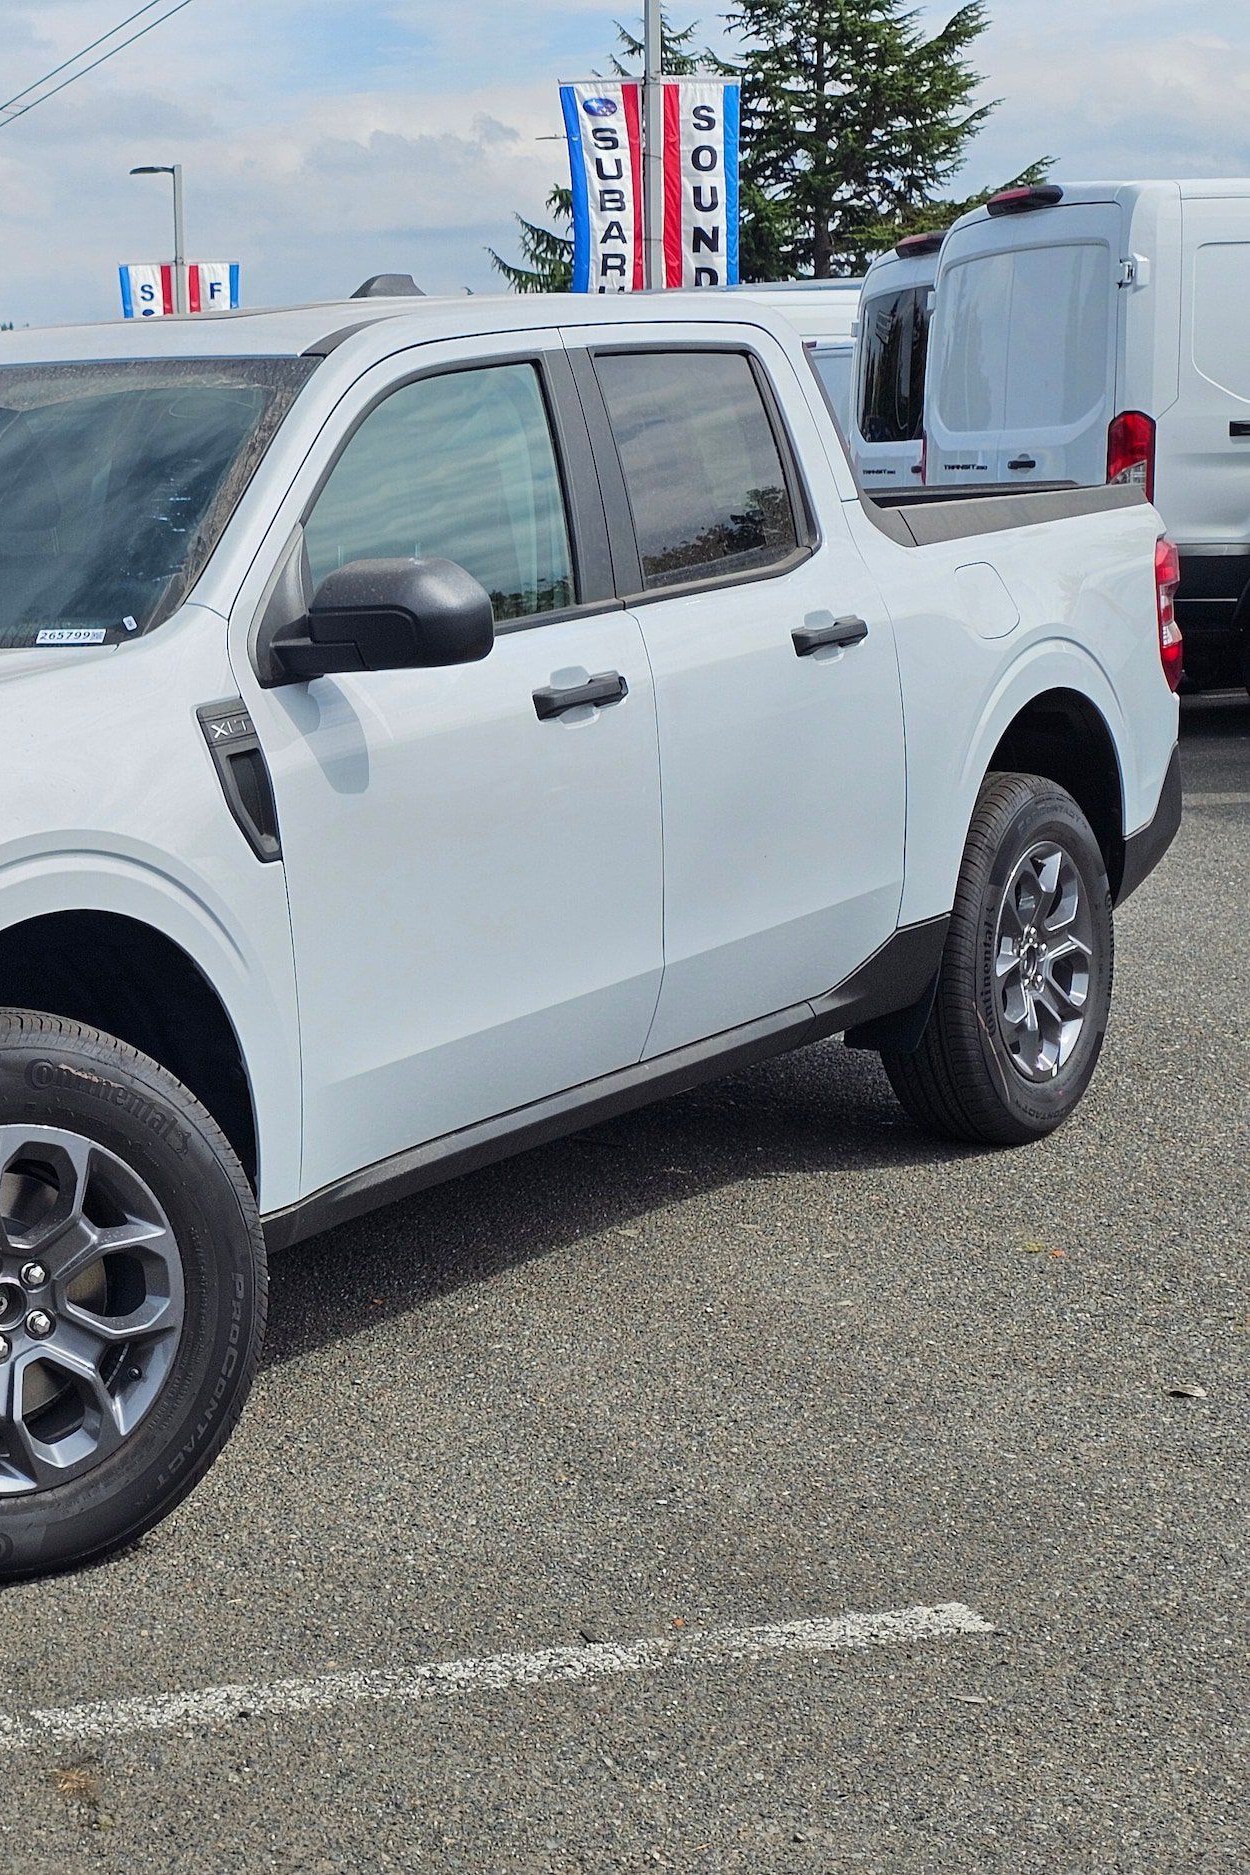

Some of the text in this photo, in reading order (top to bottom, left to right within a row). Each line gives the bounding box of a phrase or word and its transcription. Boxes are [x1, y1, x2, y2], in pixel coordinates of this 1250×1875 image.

[591, 127, 627, 294] SUBAR
[691, 105, 720, 287] SOUND
[39, 631, 90, 640] 265799
[210, 719, 248, 739] XLT
[24, 1058, 179, 1143] Continental
[156, 1272, 245, 1490] PROCONTACT
